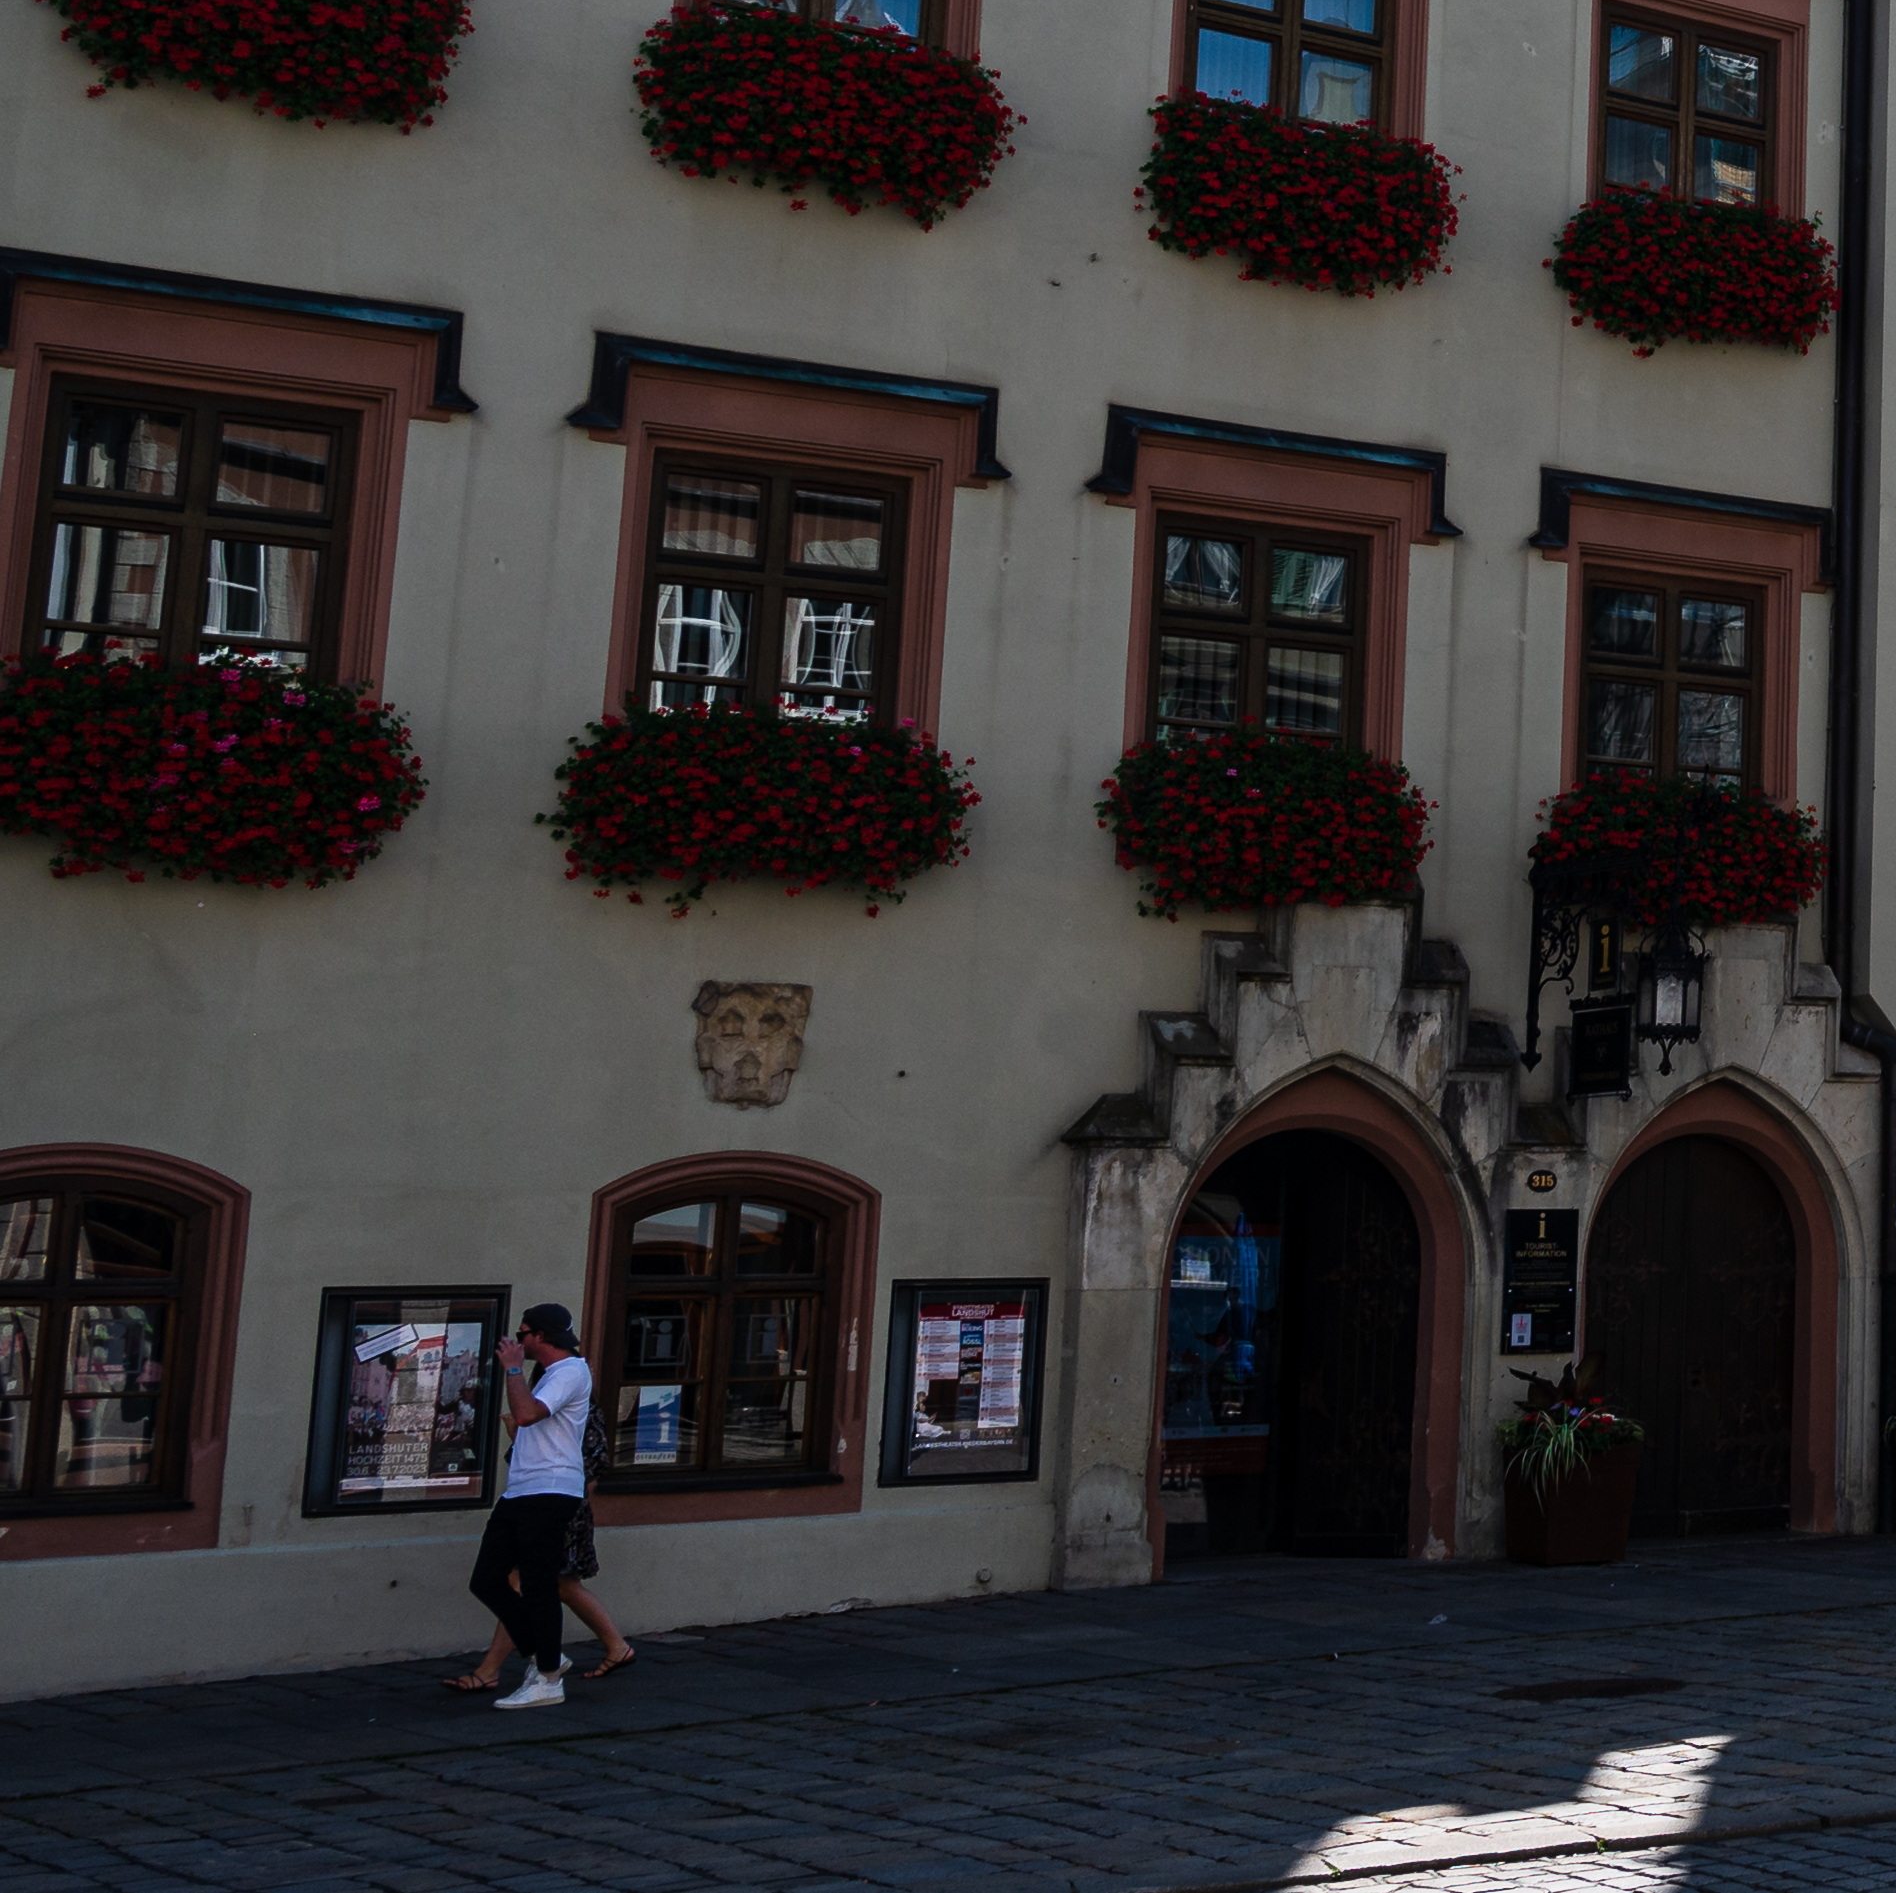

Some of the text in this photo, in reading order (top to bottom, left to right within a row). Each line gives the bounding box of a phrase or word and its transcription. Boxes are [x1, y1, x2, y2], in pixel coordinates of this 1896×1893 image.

[1585, 1021, 1619, 1036] RATHAUS
[1531, 1175, 1554, 1187] 315
[1525, 1242, 1559, 1250] TOURIST-
[1515, 1250, 1567, 1258] INFORMATION
[951, 1308, 994, 1317] LANDSHUT
[349, 1443, 427, 1454] LANDSHUTER
[348, 1454, 400, 1464] HOCHZEIT
[404, 1453, 427, 1462] 1475
